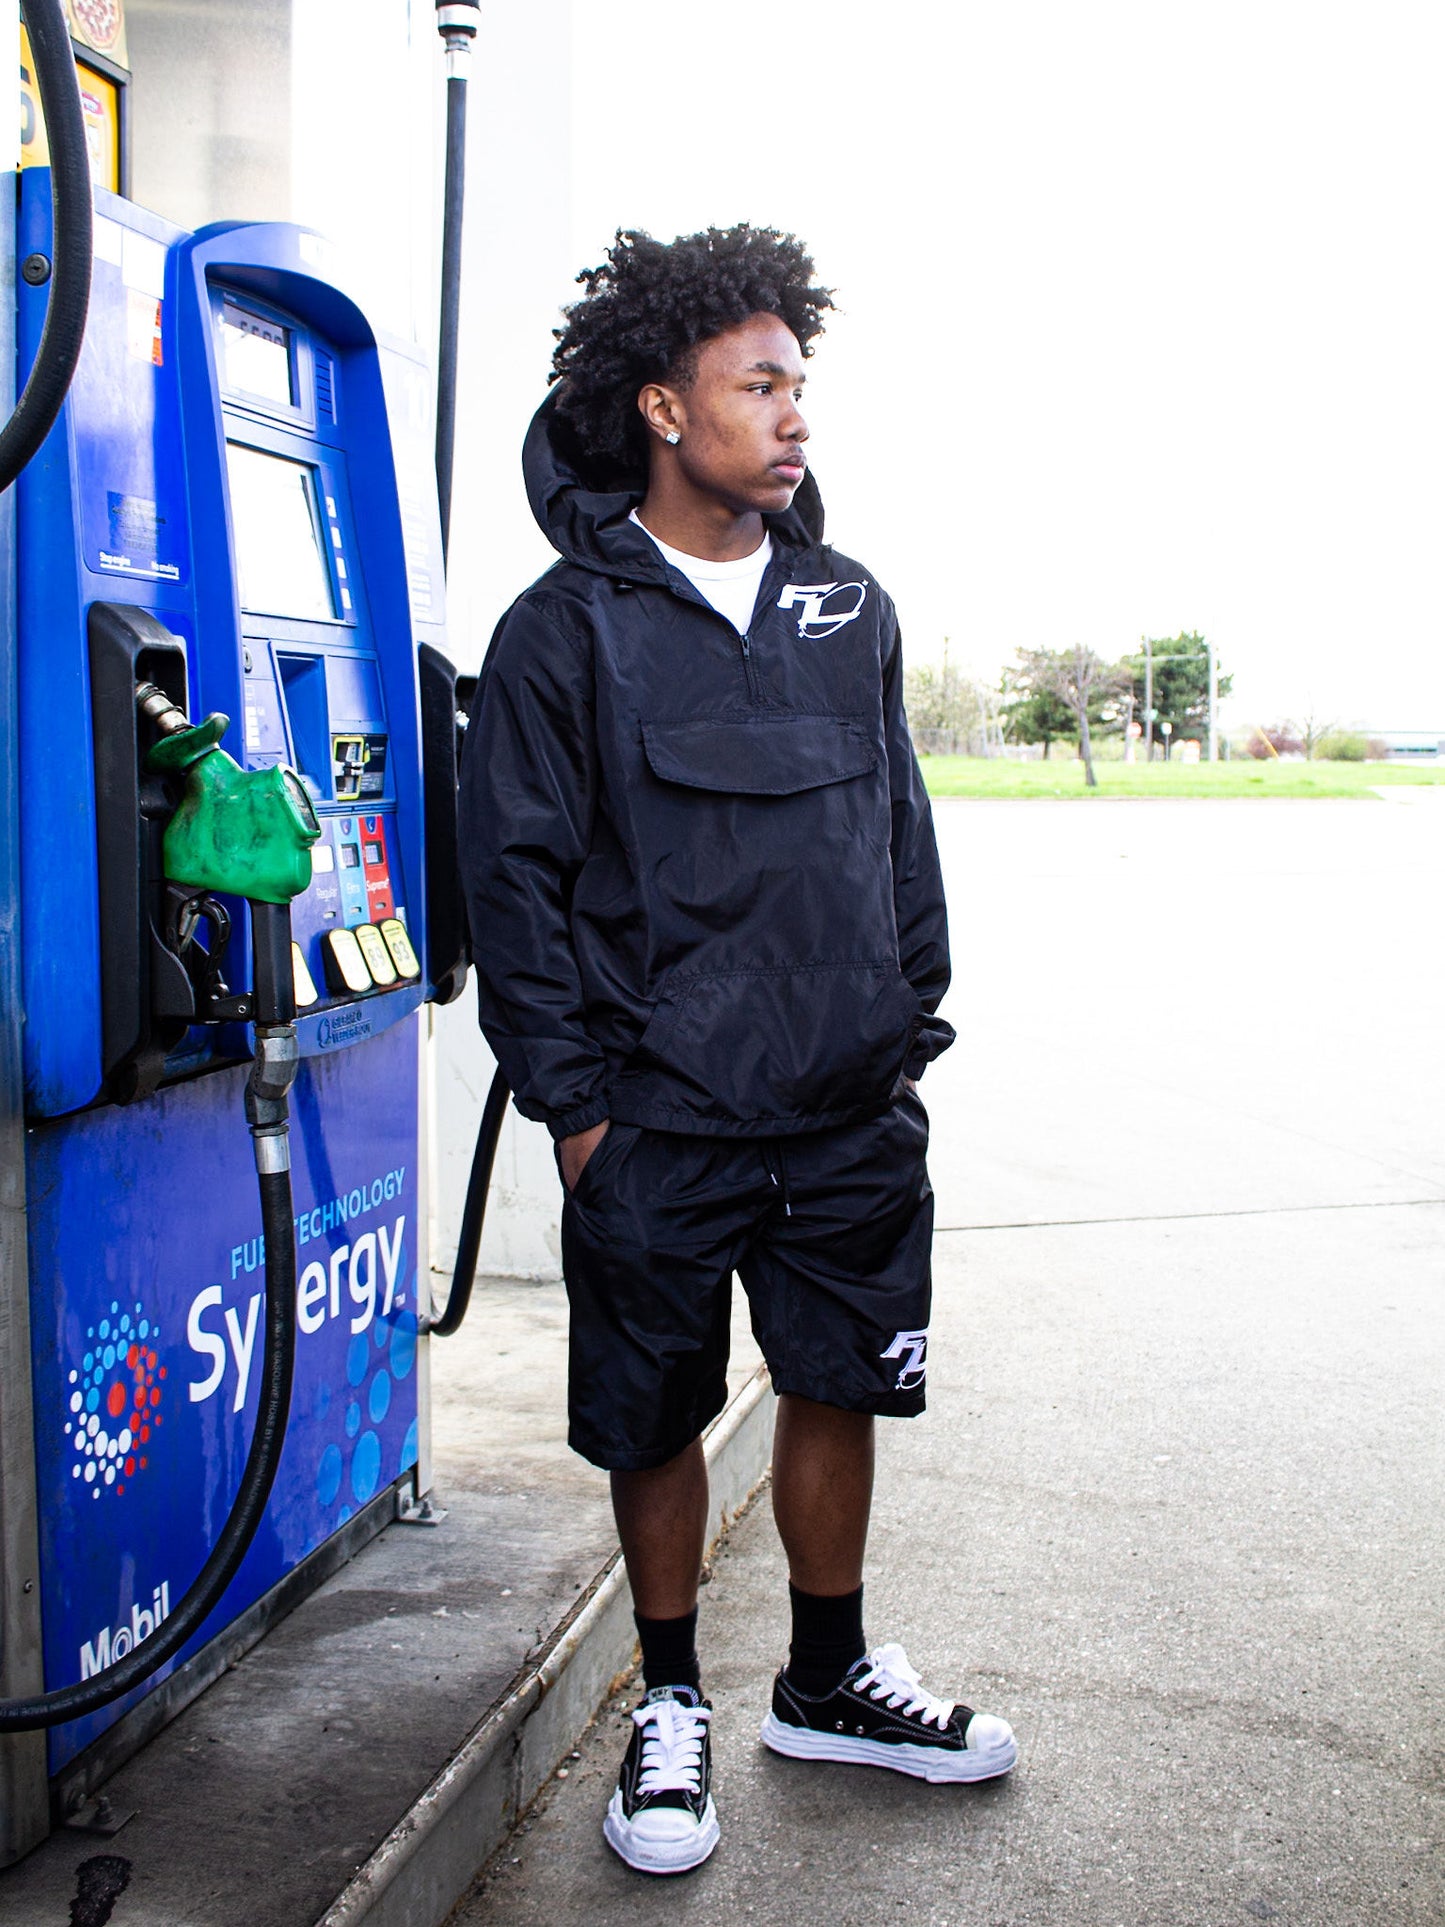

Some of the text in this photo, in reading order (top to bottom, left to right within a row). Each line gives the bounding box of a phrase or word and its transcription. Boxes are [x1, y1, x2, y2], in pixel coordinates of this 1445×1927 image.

[231, 1166, 406, 1280] FUE ECHNOLOGY
[186, 1214, 405, 1414] Syergy
[79, 1579, 170, 1682] Mobil
